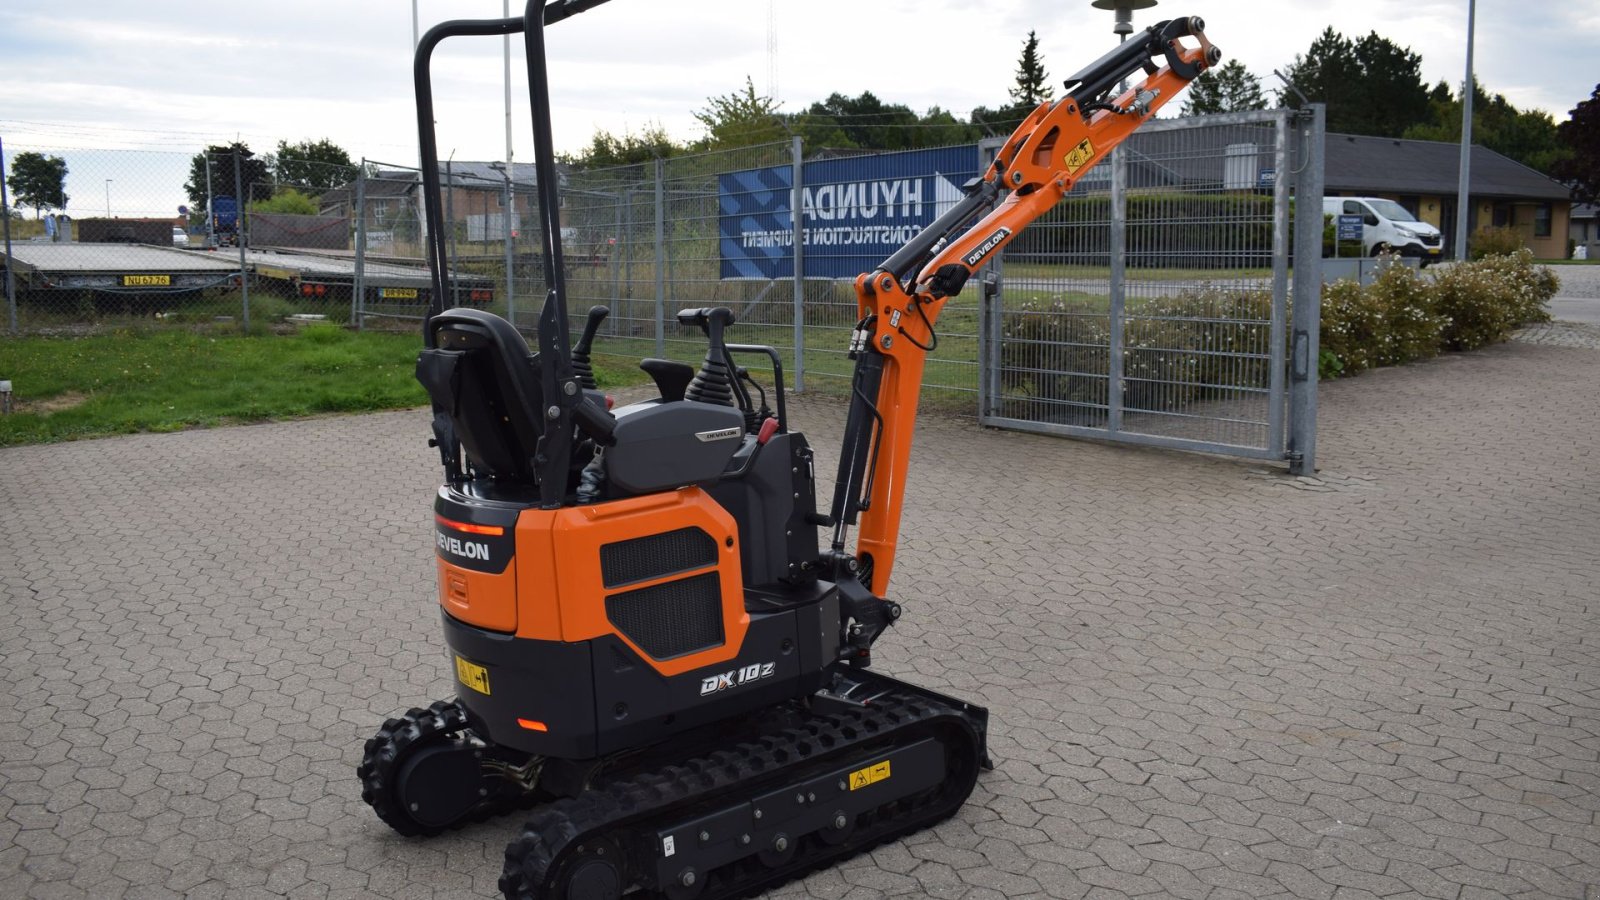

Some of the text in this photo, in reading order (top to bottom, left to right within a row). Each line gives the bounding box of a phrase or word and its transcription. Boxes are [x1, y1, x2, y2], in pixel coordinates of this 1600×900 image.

[968, 231, 1005, 265] DEVELON
[706, 431, 737, 439] DEVELON
[436, 529, 490, 561] DEVELON
